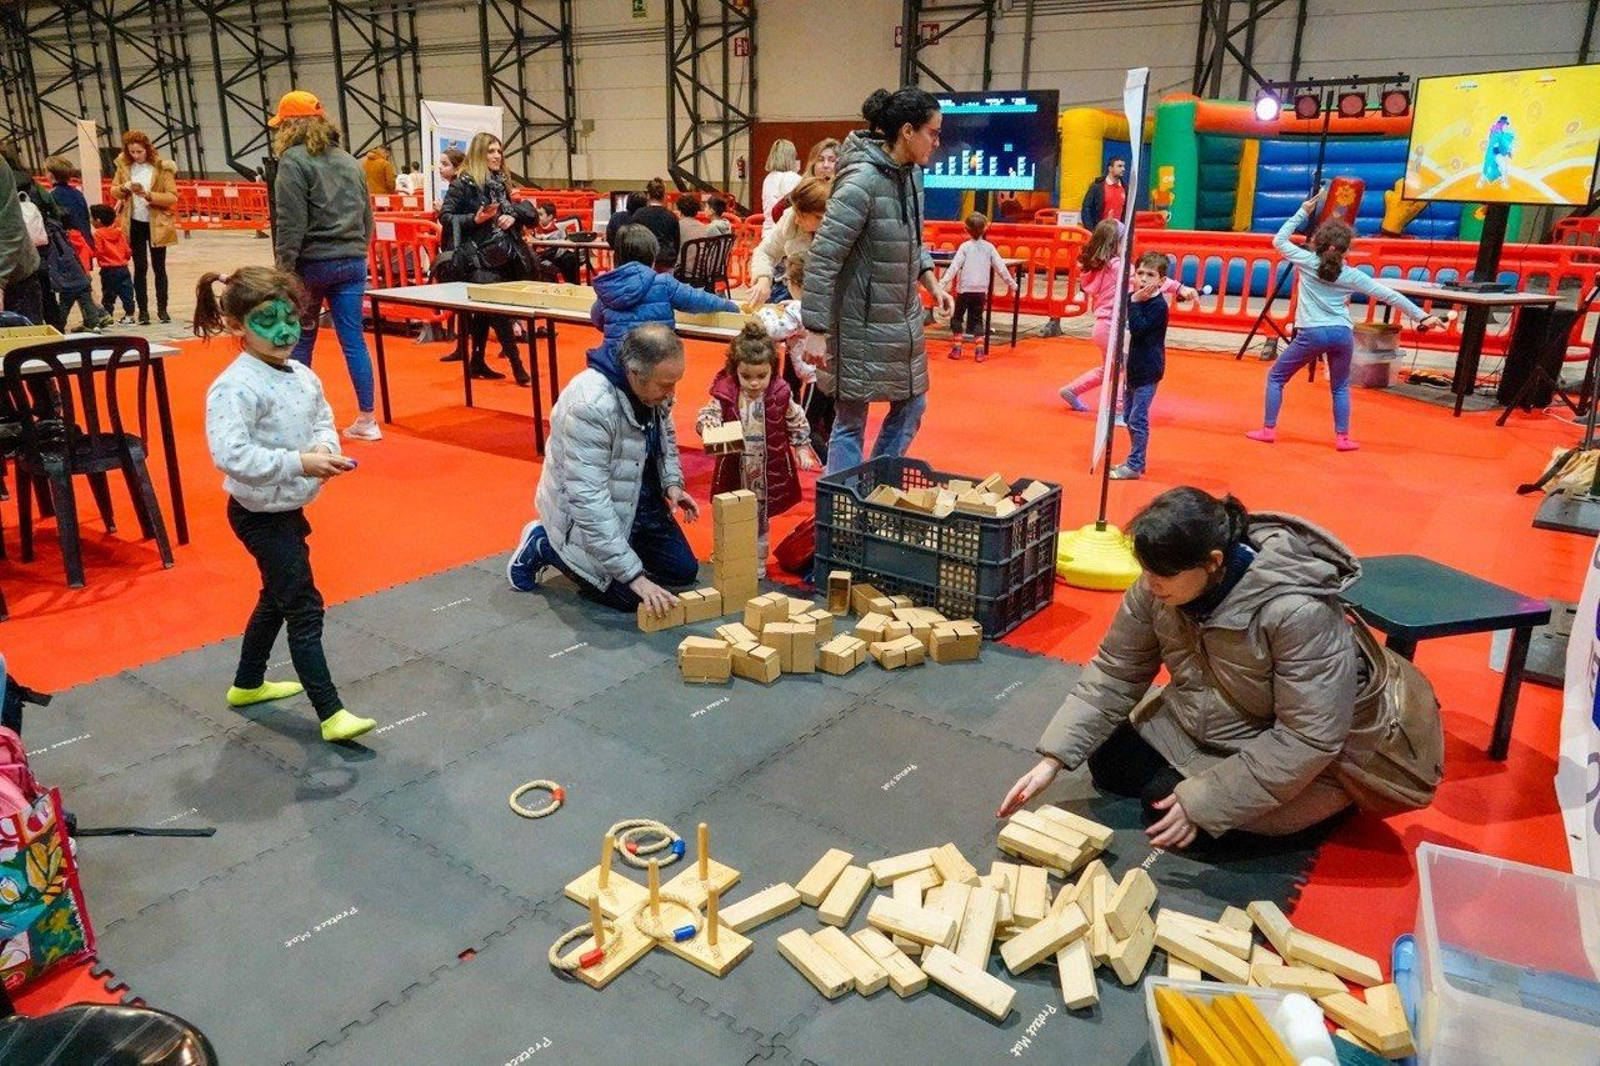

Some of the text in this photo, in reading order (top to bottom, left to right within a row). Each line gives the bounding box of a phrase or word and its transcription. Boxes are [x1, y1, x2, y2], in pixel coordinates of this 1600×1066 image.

[284, 906, 359, 948] Protect Mat
[1009, 1004, 1057, 1057] Protect Mat
